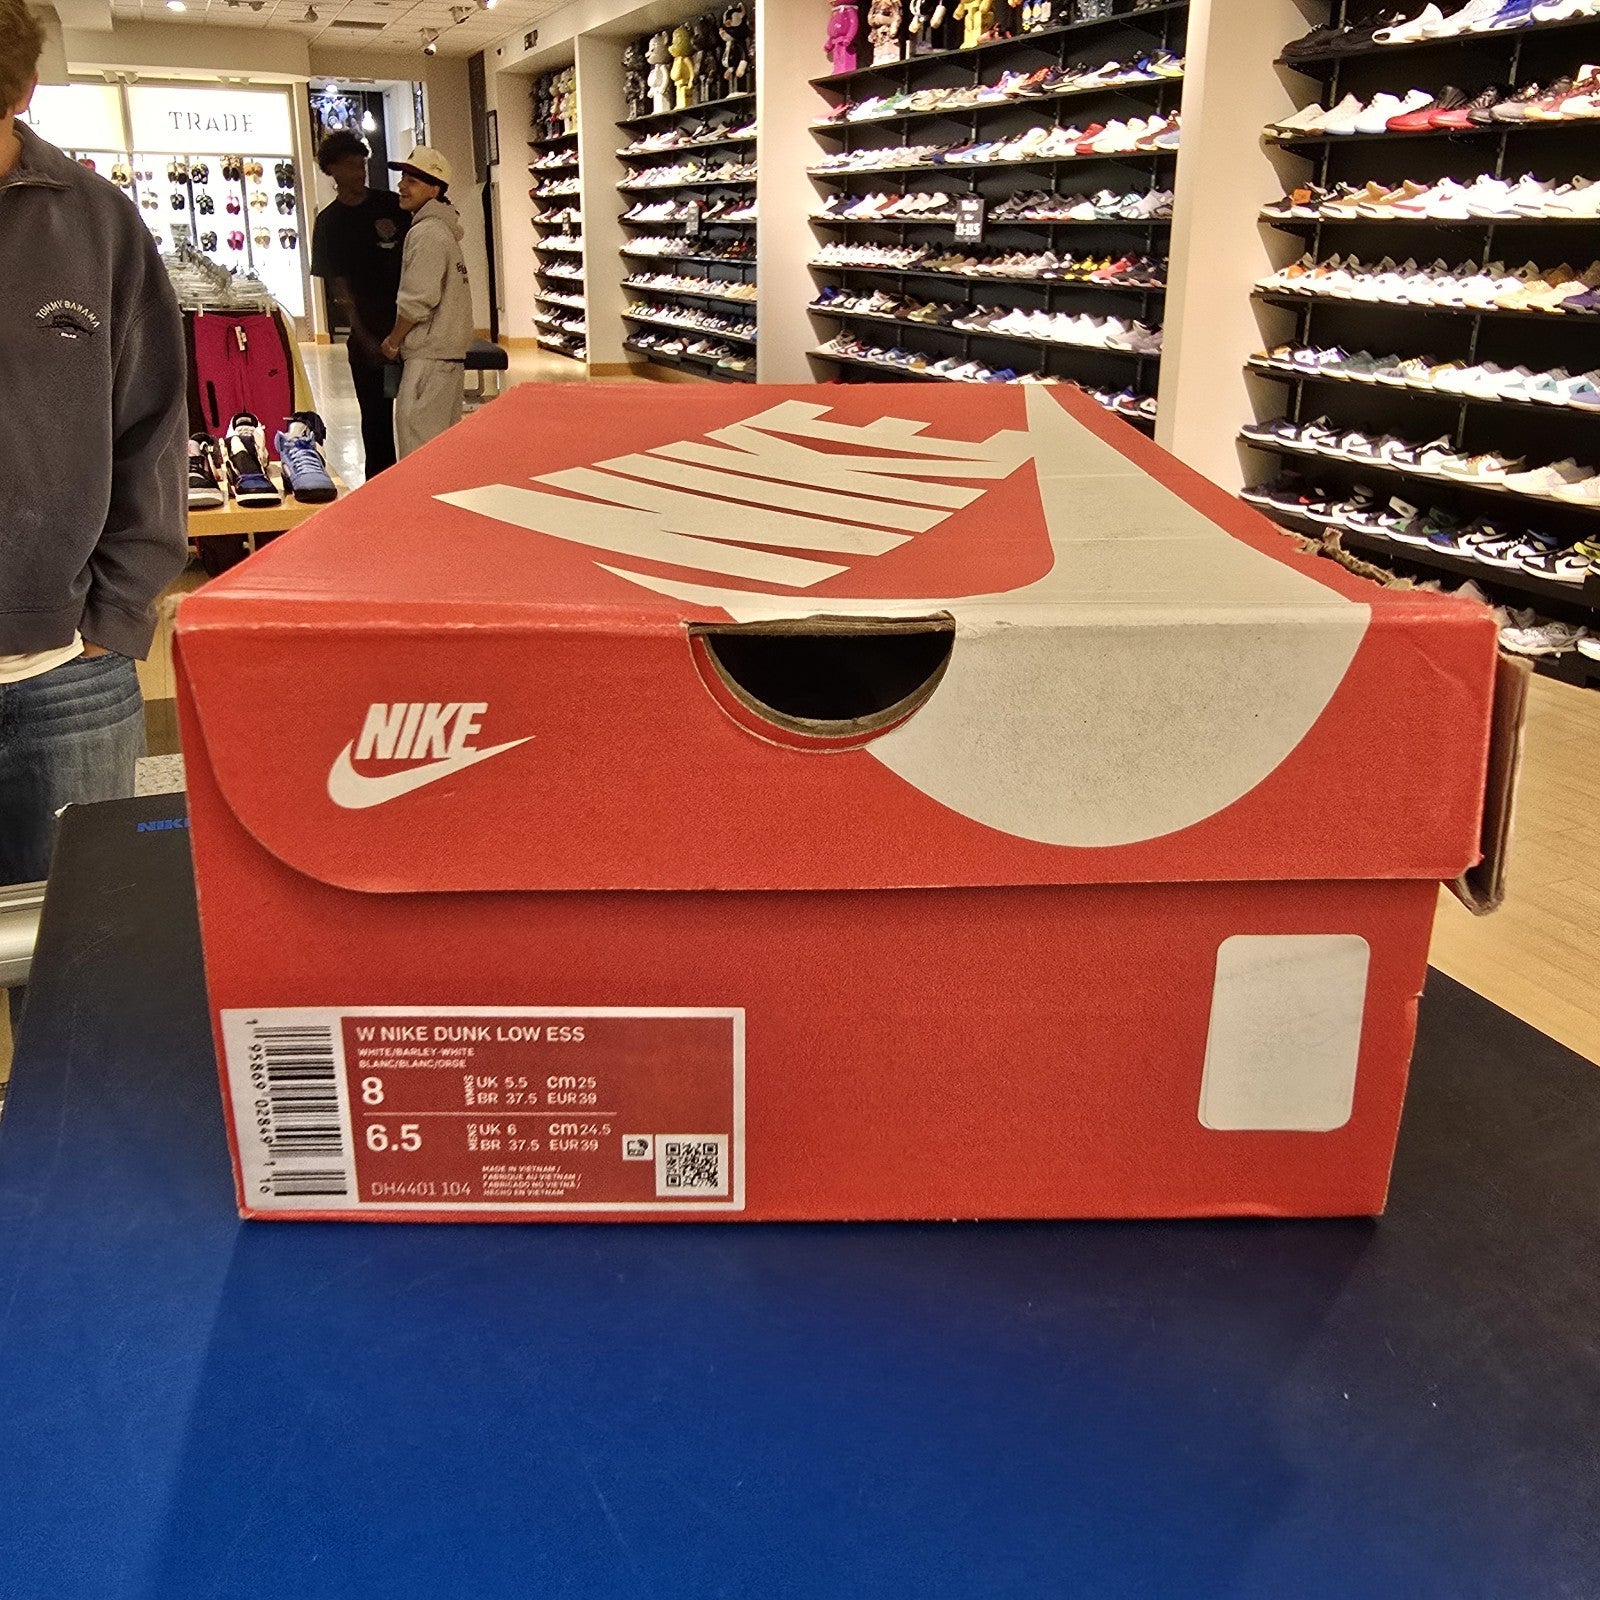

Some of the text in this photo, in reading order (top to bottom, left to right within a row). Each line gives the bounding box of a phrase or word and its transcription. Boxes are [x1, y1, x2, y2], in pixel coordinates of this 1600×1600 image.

[168, 111, 253, 132] TRADE
[36, 300, 101, 329] TOMMY BAHAMA
[431, 399, 1030, 589] NIKE
[354, 702, 488, 760] NIKE
[355, 1026, 586, 1042] W NIKE DUNK LOW ESS
[361, 1076, 385, 1106] 8
[476, 1076, 498, 1089] UK
[504, 1076, 528, 1090] 5.5
[477, 1092, 499, 1105] BR
[506, 1092, 538, 1106] 37.5
[366, 1123, 423, 1152] 6.5
[479, 1123, 501, 1136] UK
[507, 1123, 518, 1136] 6
[480, 1138, 501, 1151] BR
[508, 1139, 540, 1152] 37.5
[482, 1165, 506, 1173] MADE
[371, 1181, 472, 1196] DH4401 104
